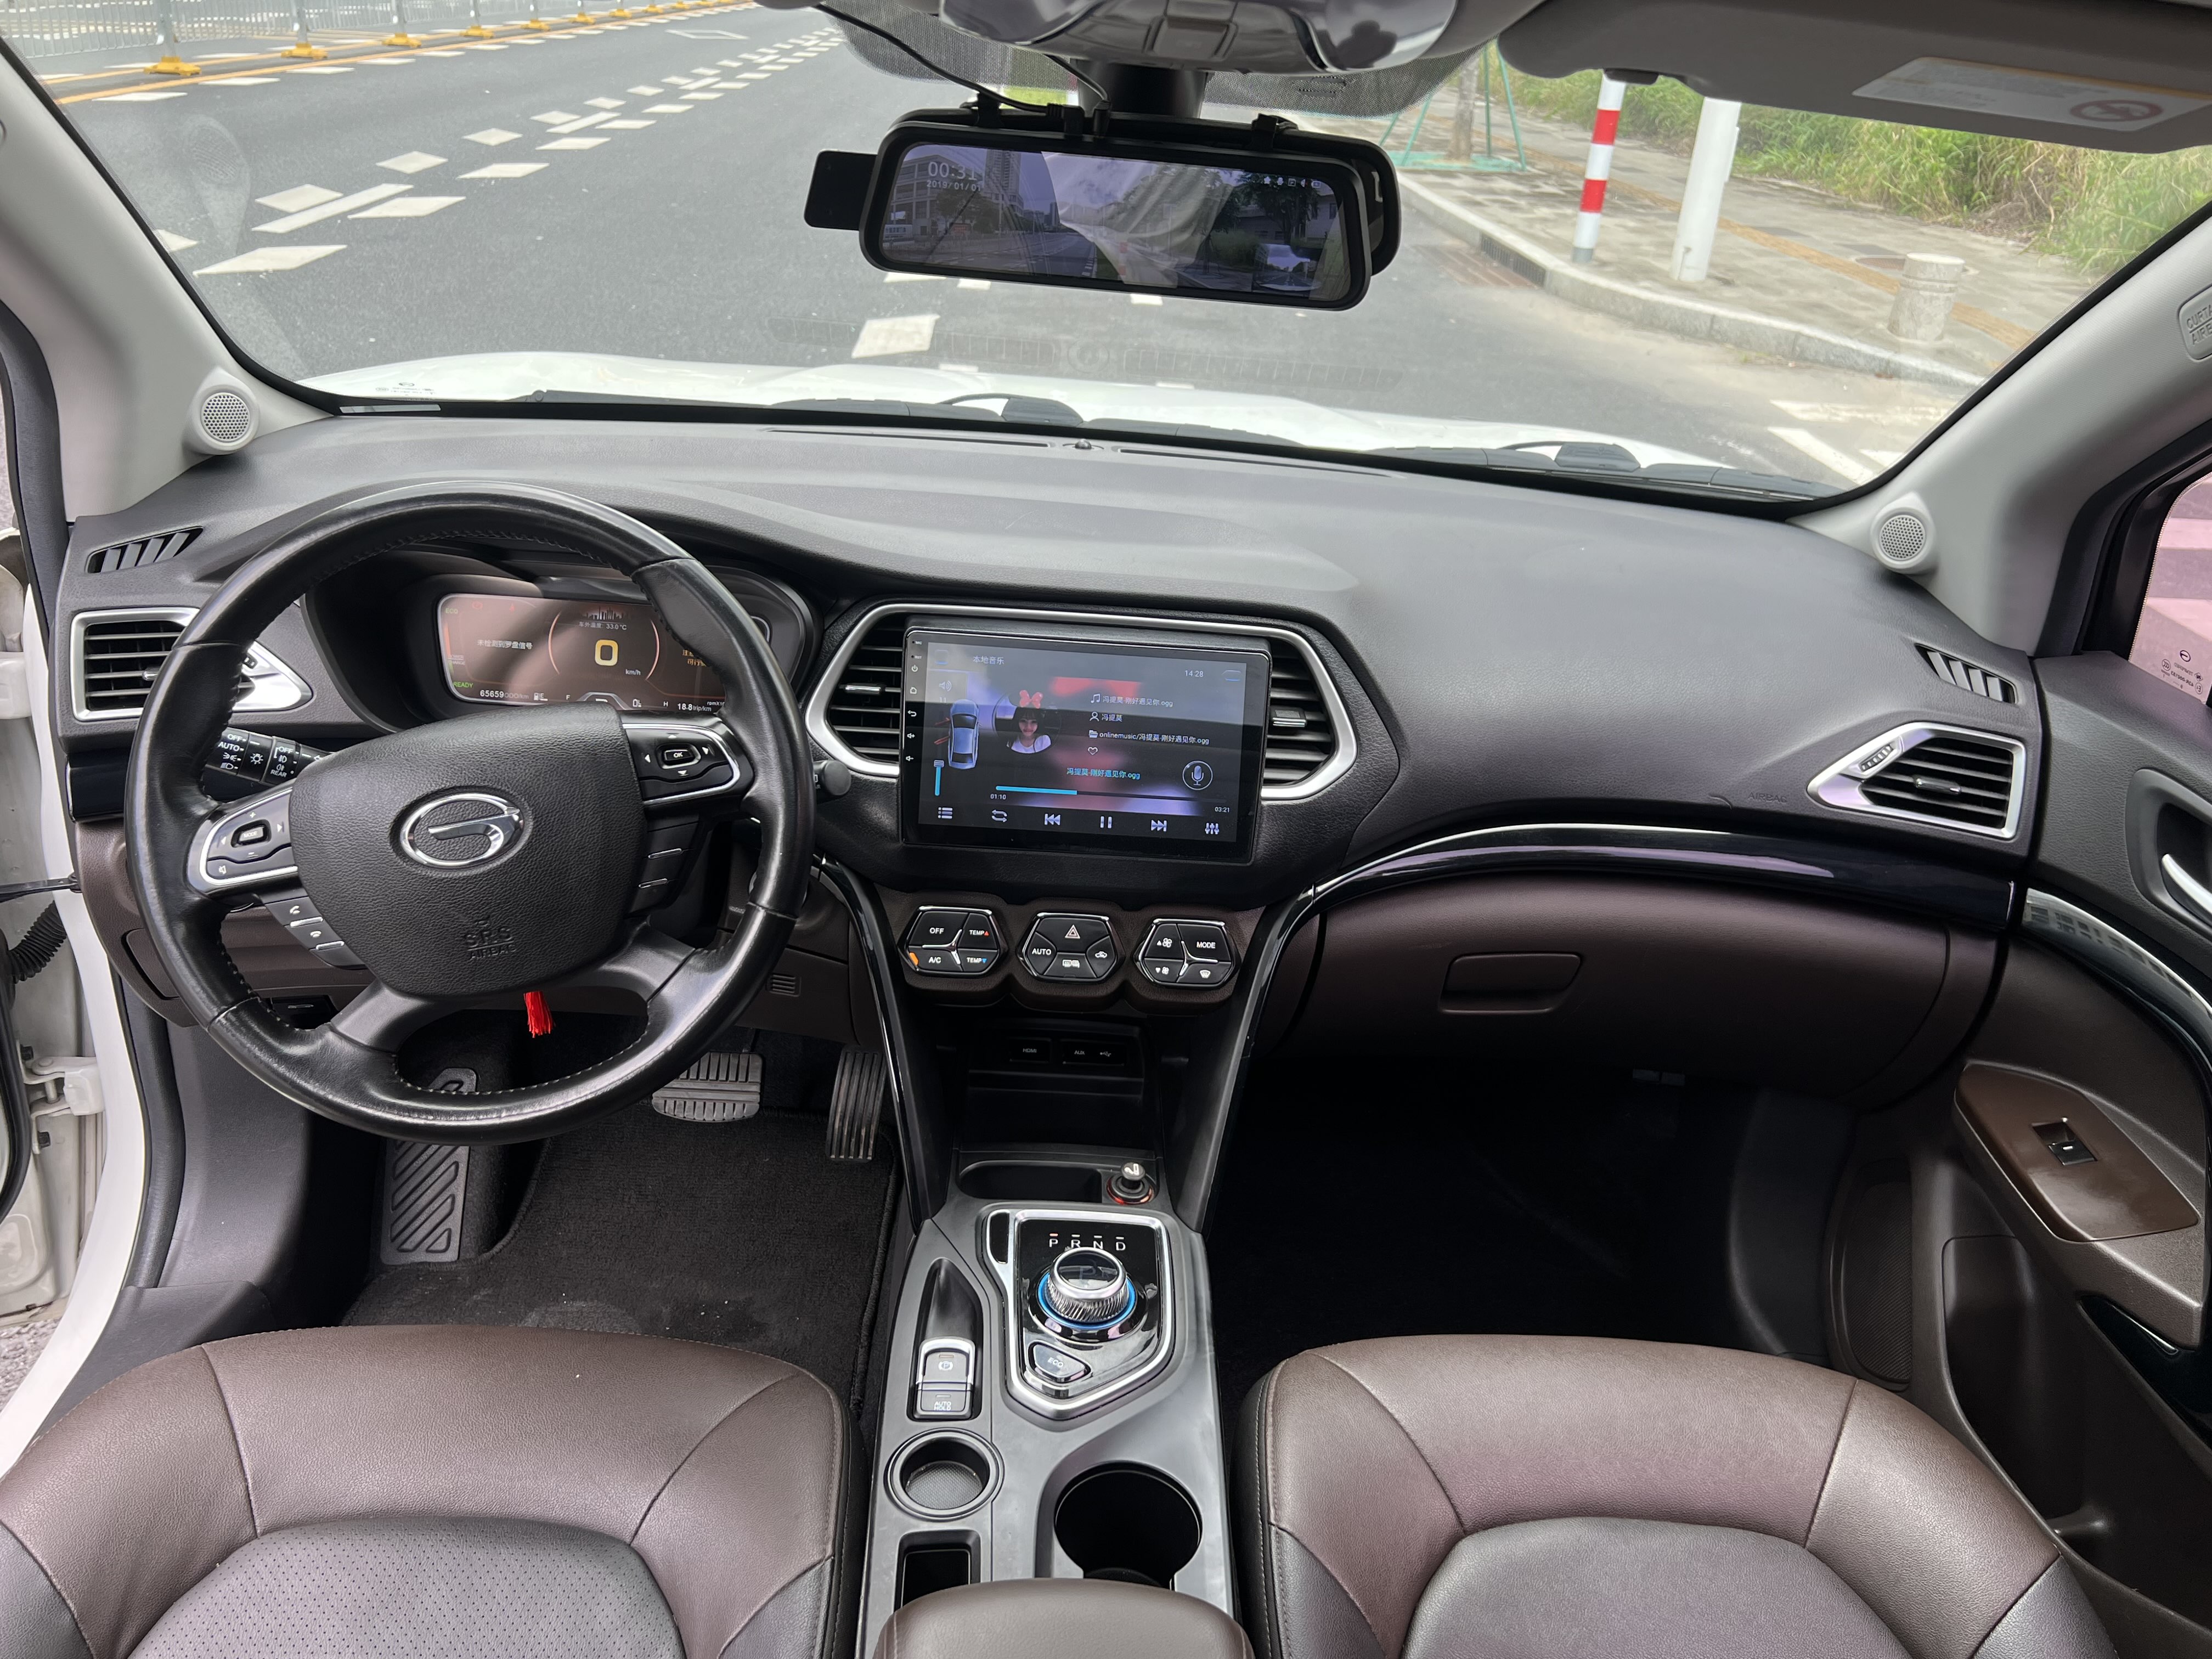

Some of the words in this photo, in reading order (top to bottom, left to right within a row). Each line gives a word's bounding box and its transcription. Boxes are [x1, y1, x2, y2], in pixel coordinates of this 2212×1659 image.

[928, 162, 977, 180] 00:31
[927, 180, 981, 191] 2019/01/01
[595, 639, 618, 666] 0
[973, 655, 1005, 665] 本地音乐
[480, 690, 504, 698] 65659
[1101, 714, 1122, 722] 冯提莫
[227, 733, 243, 742] OFF
[218, 741, 240, 751] AUTO
[278, 746, 294, 754] OFF
[270, 769, 287, 778] REAR
[1747, 792, 1787, 803] AIRBAG
[1049, 1238, 1058, 1248] P
[1071, 1239, 1081, 1248] R
[1093, 1240, 1103, 1250] N
[1116, 1242, 1126, 1251] D
[1048, 1357, 1064, 1368] ECO
